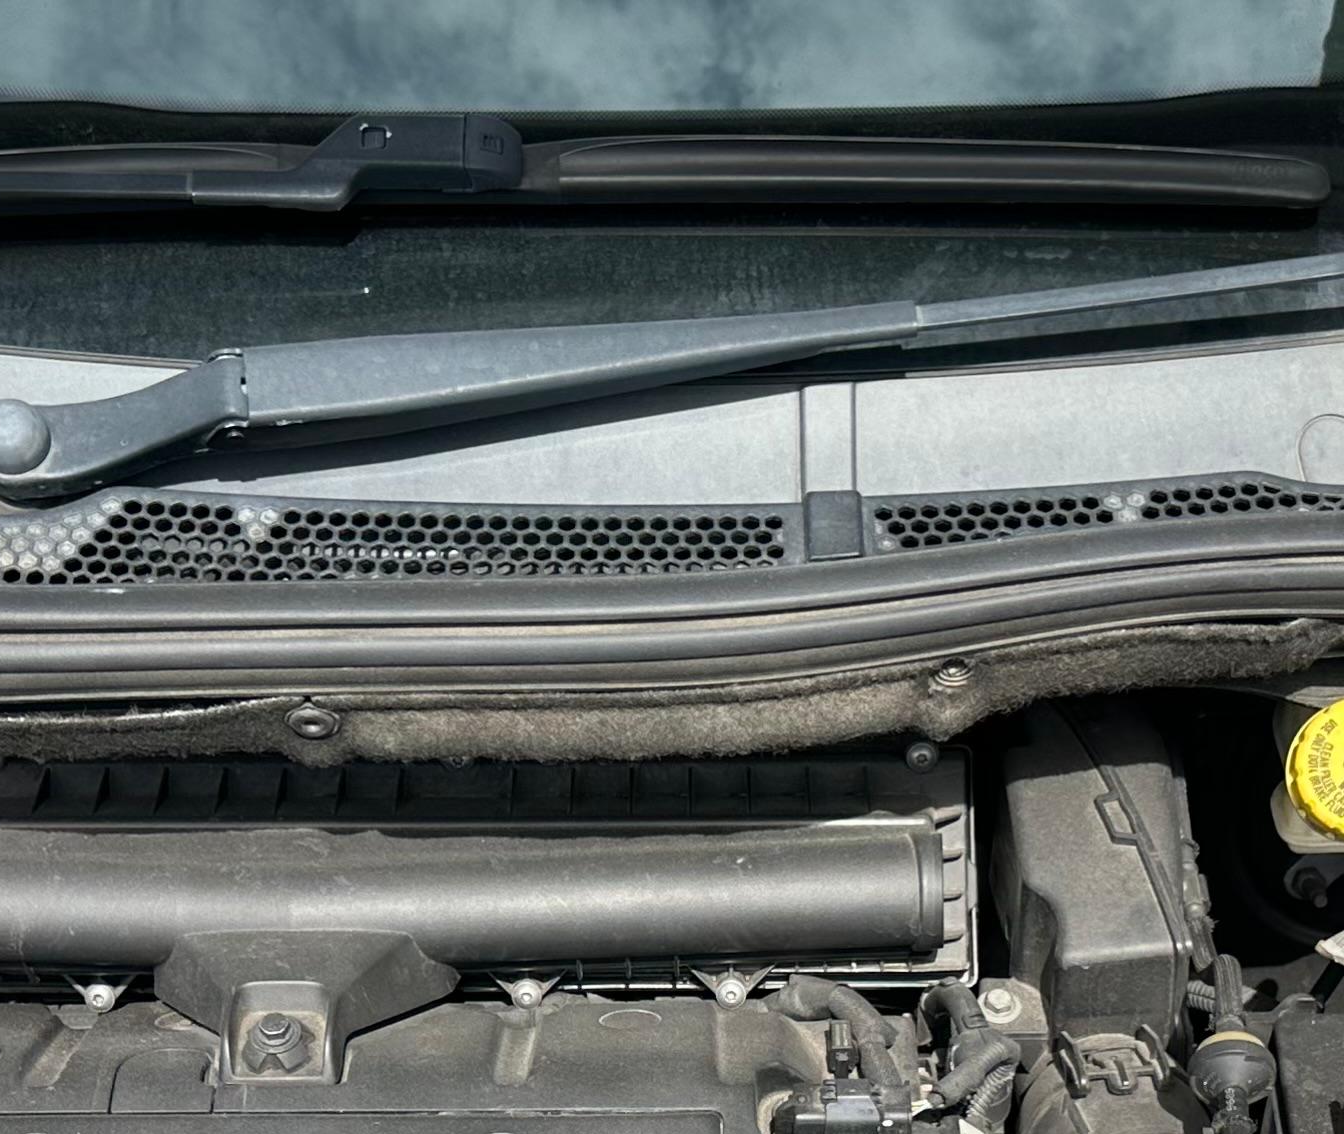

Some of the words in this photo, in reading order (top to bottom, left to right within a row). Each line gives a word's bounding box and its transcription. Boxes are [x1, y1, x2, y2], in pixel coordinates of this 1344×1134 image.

[1323, 719, 1338, 734] USE
[1318, 742, 1334, 768] CLEAN
[1309, 776, 1326, 802] BRAKE
